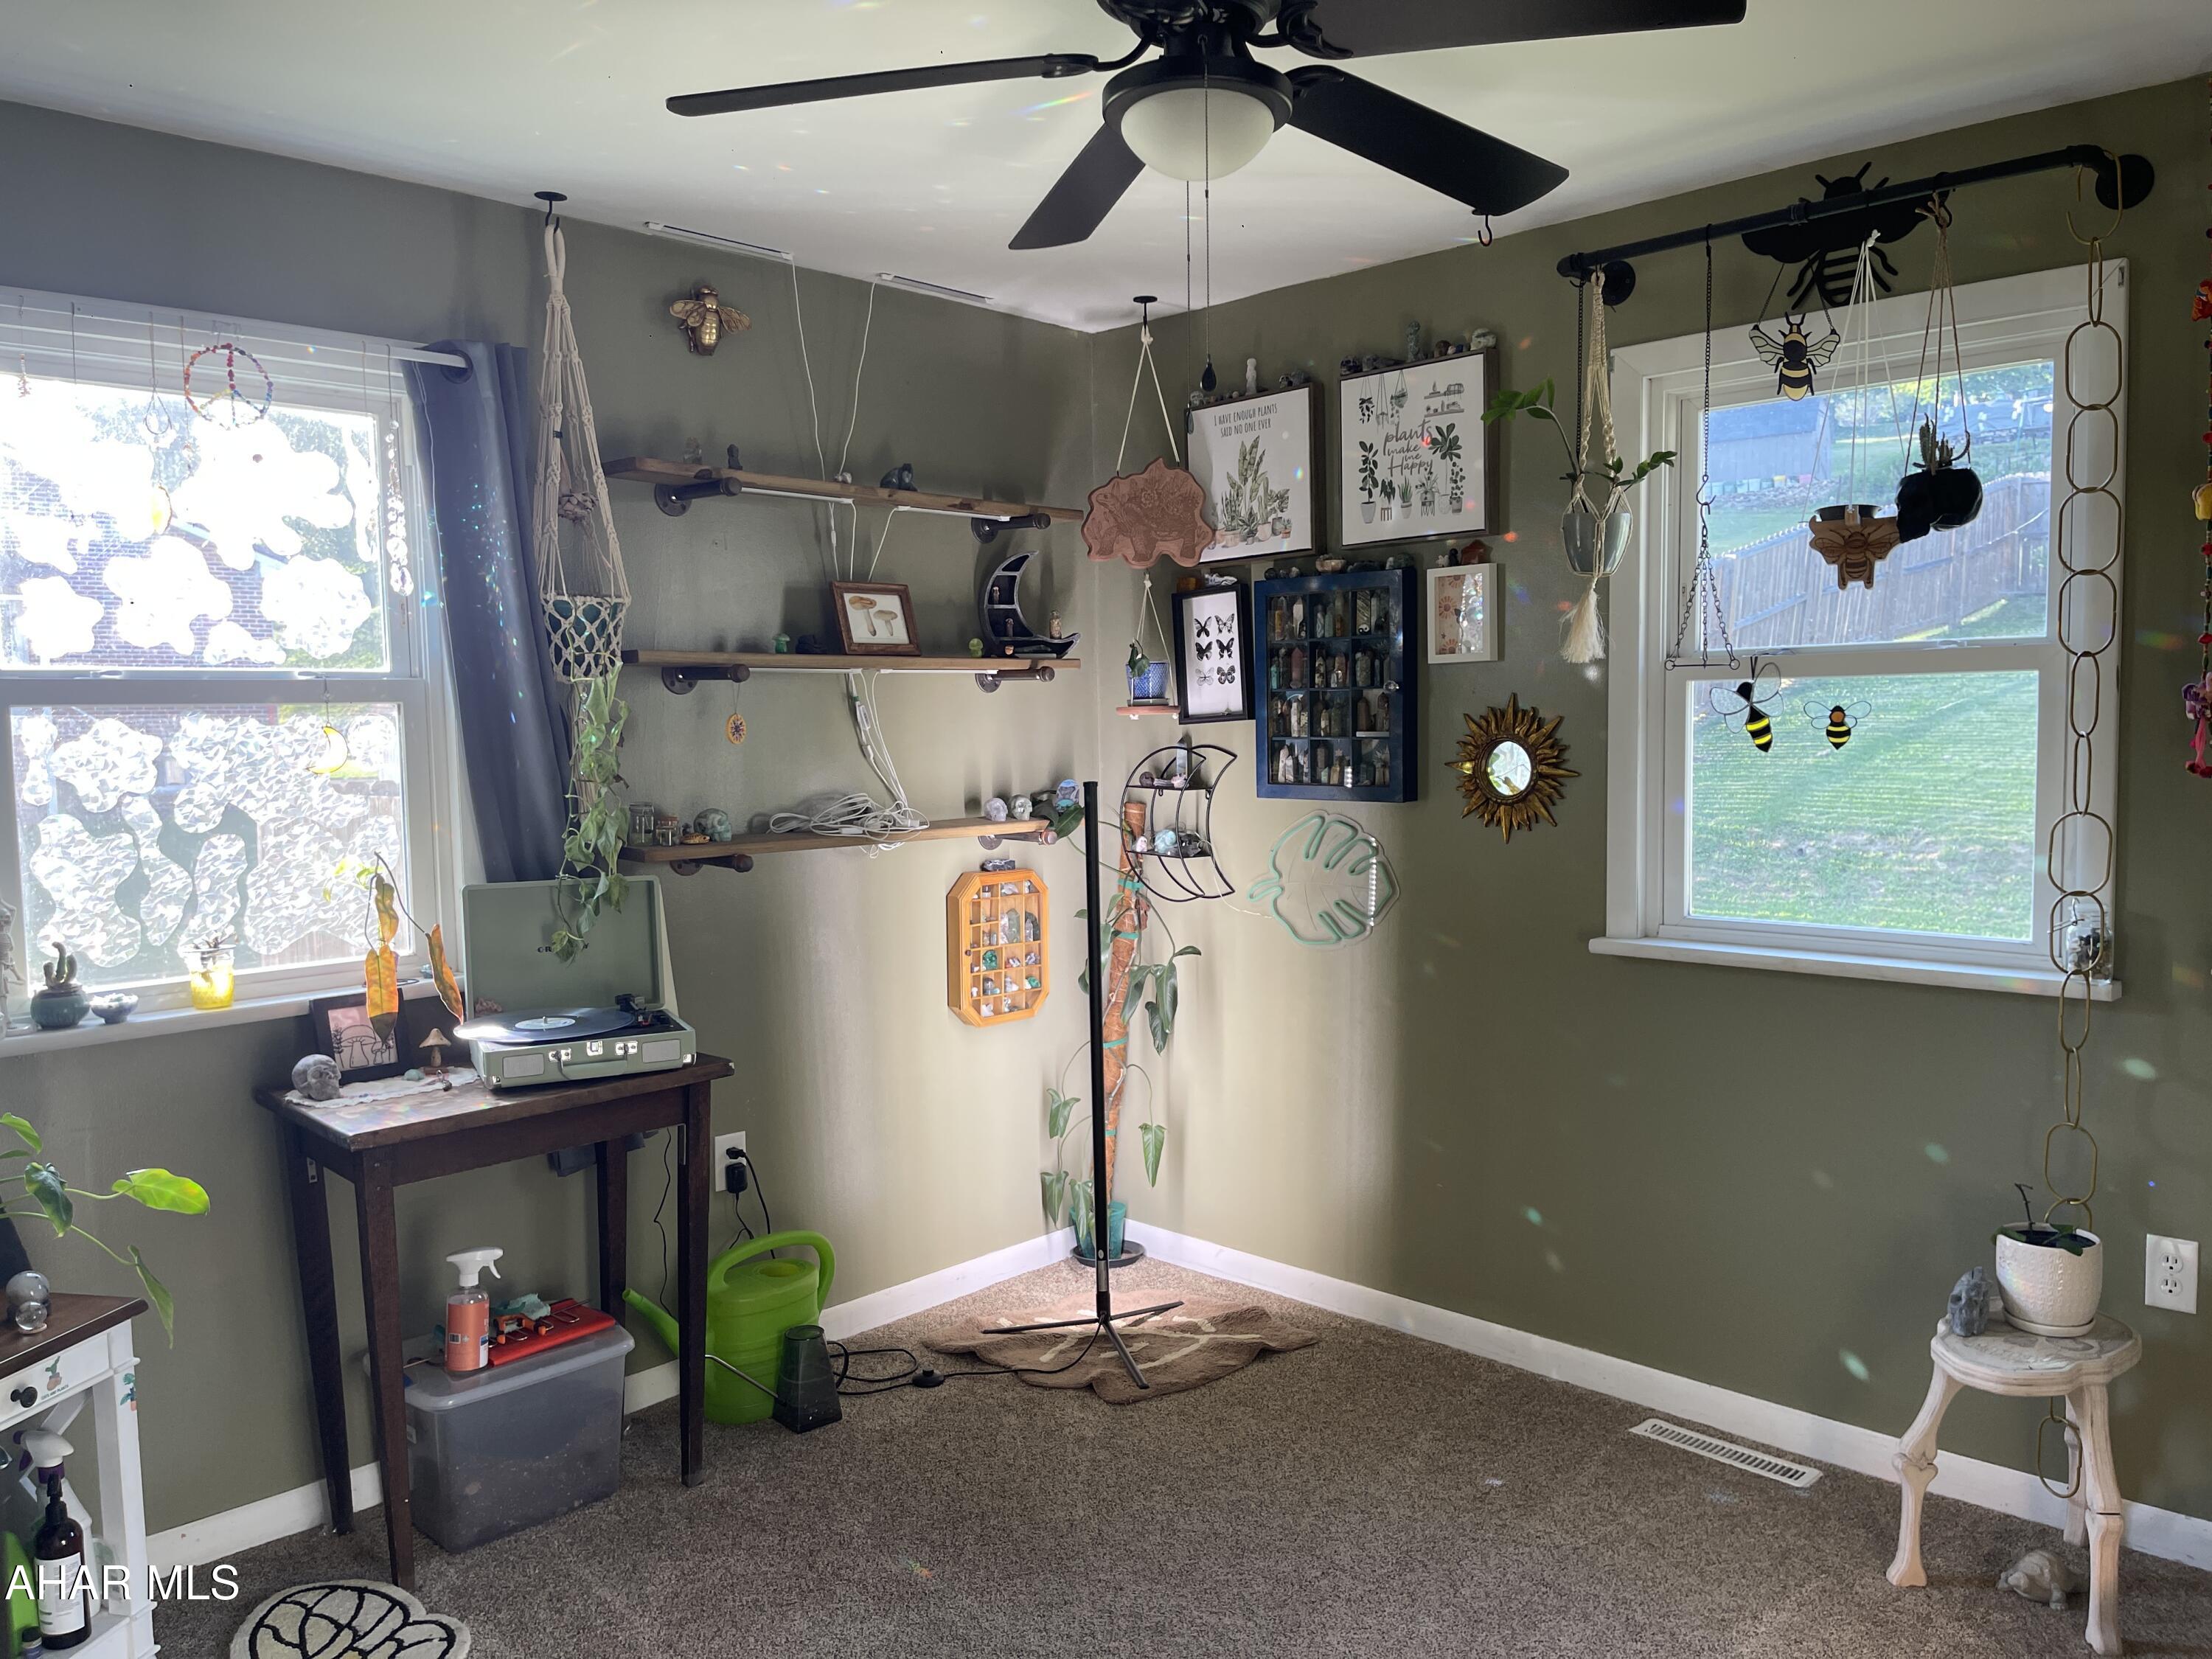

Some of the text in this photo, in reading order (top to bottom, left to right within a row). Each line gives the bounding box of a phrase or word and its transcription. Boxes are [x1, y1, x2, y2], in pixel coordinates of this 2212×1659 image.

[1214, 403, 1277, 426] I HAVE ENOUGH PLANTS
[1221, 418, 1271, 438] SAID NO ONE EVER
[1383, 418, 1433, 456] plants
[1388, 439, 1421, 456] make
[1405, 453, 1422, 462] me
[1387, 455, 1433, 477] Happy
